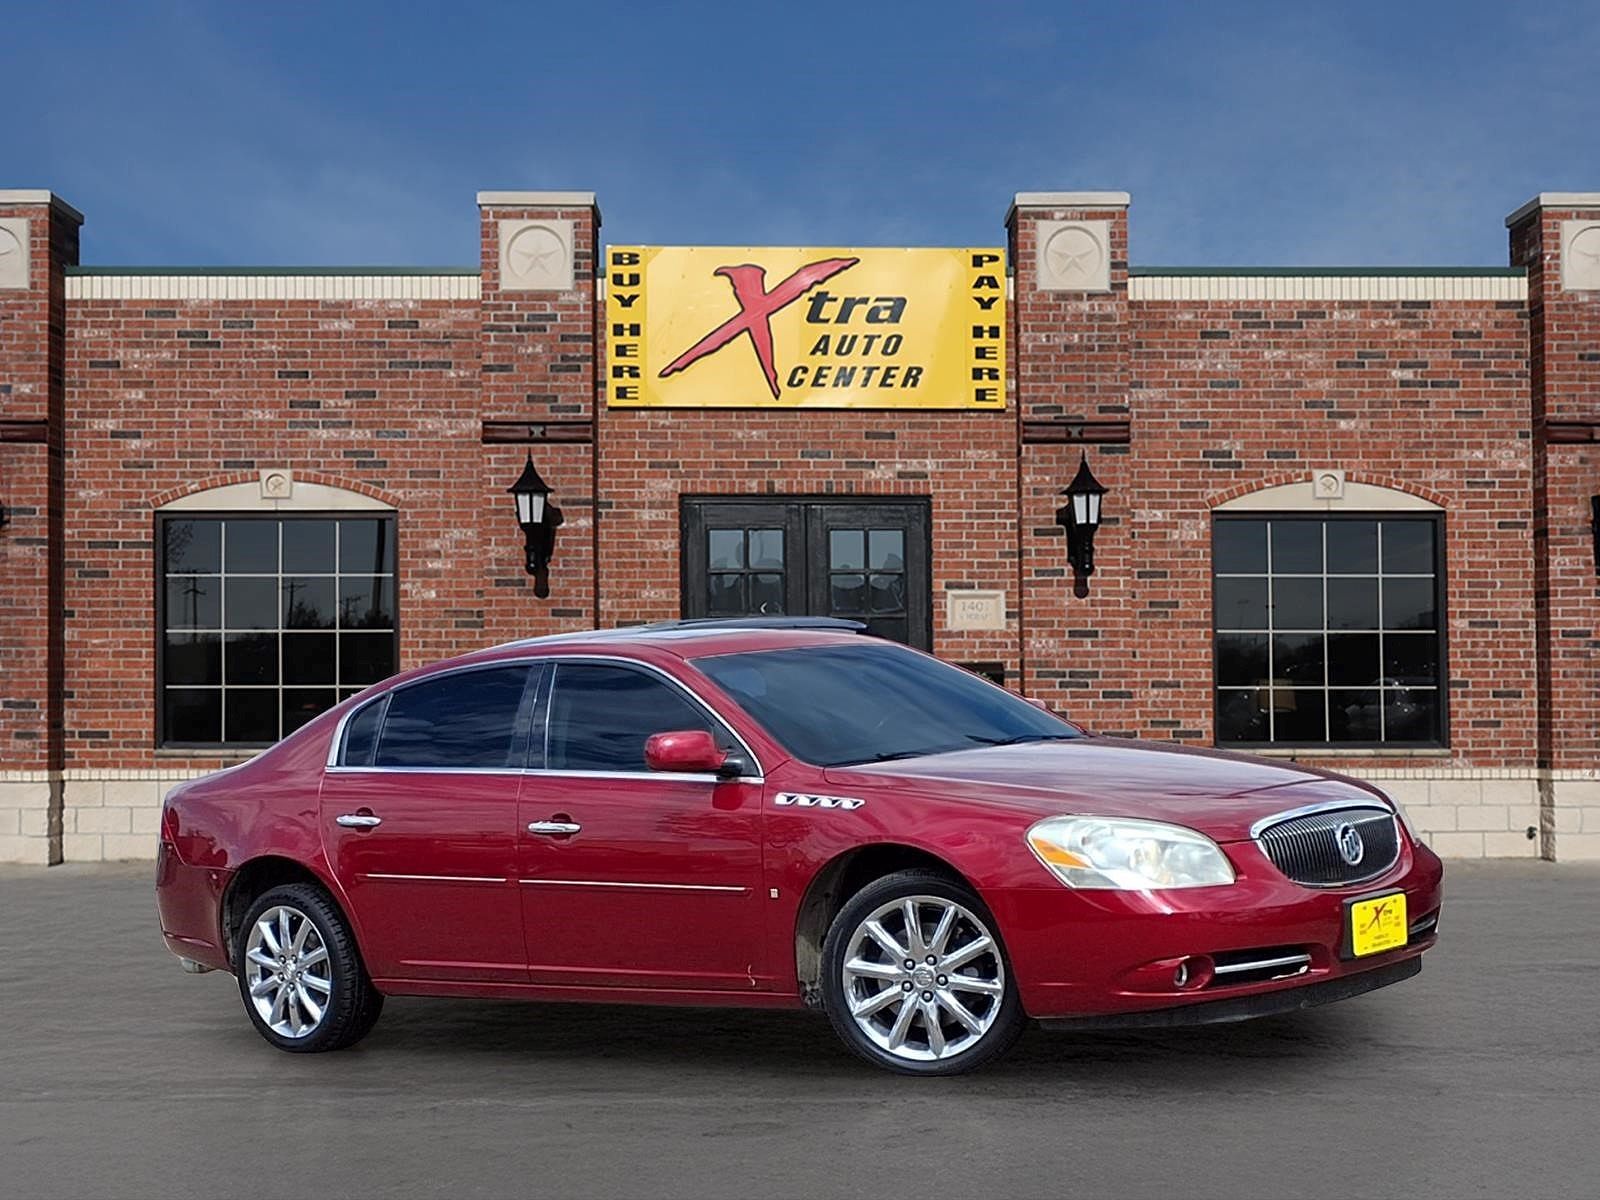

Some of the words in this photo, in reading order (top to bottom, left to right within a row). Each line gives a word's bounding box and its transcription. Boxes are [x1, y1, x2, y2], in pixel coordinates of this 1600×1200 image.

[611, 252, 641, 308] BUY
[972, 254, 1001, 311] PAY
[658, 257, 908, 400] Xtra
[809, 334, 904, 357] AUTO
[611, 323, 641, 400] HERE
[786, 366, 924, 389] CENTER
[972, 325, 1001, 402] HERE
